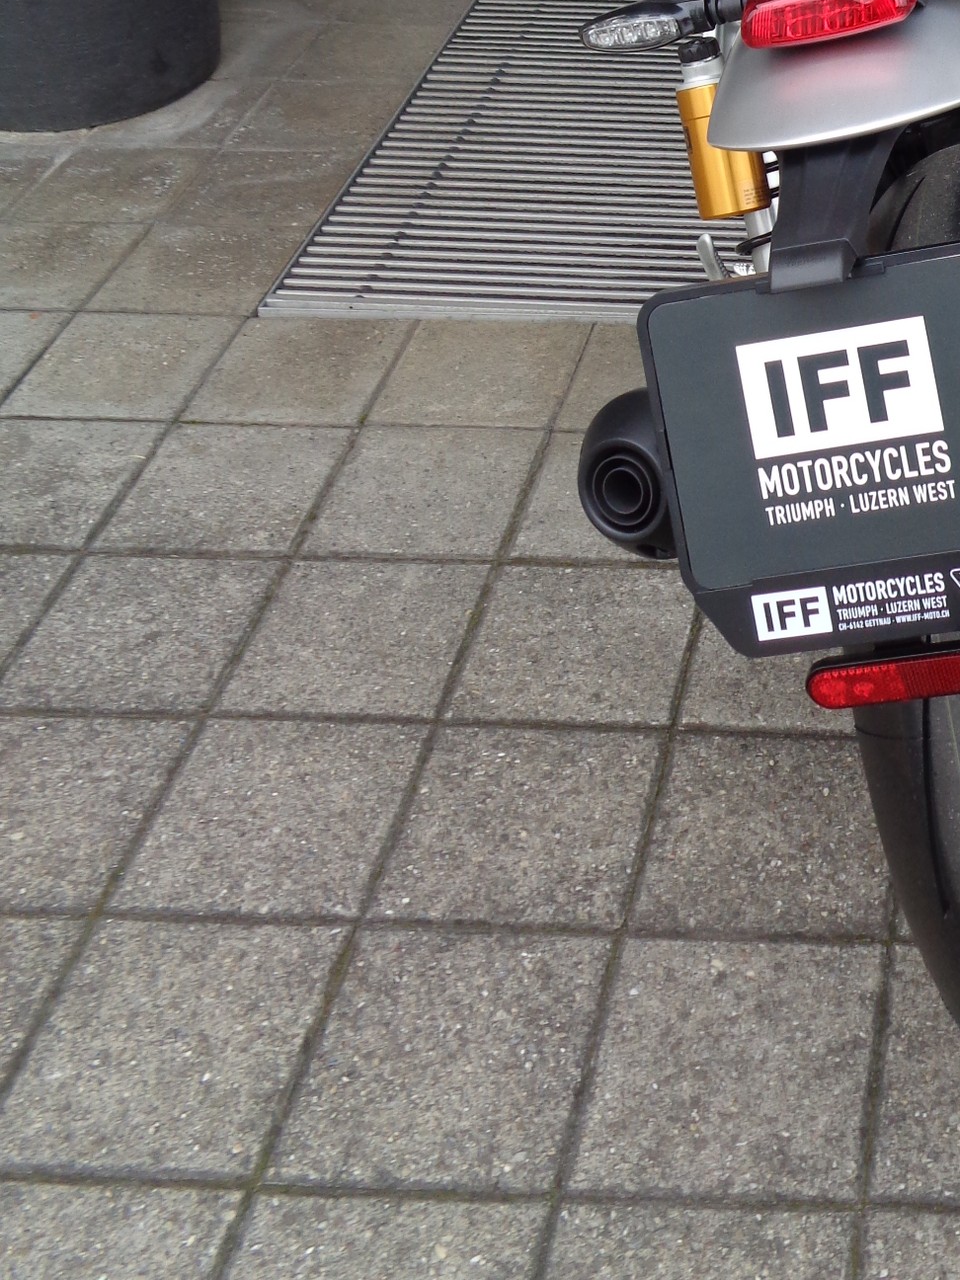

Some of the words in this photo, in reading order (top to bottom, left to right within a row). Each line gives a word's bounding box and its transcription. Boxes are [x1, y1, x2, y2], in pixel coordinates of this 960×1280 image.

[764, 339, 911, 438] IFF
[757, 439, 952, 500] MOTORCYCLES
[765, 498, 836, 526] TRIUMPH
[849, 487, 911, 514] LUZERN
[912, 480, 956, 504] WEST
[832, 572, 946, 606] MOTORCYCLES
[763, 596, 819, 633] IFF
[836, 607, 878, 622] TRIUMPH
[885, 601, 921, 615] LUZERN
[922, 595, 948, 610] WEST
[838, 621, 864, 632] CH-6142
